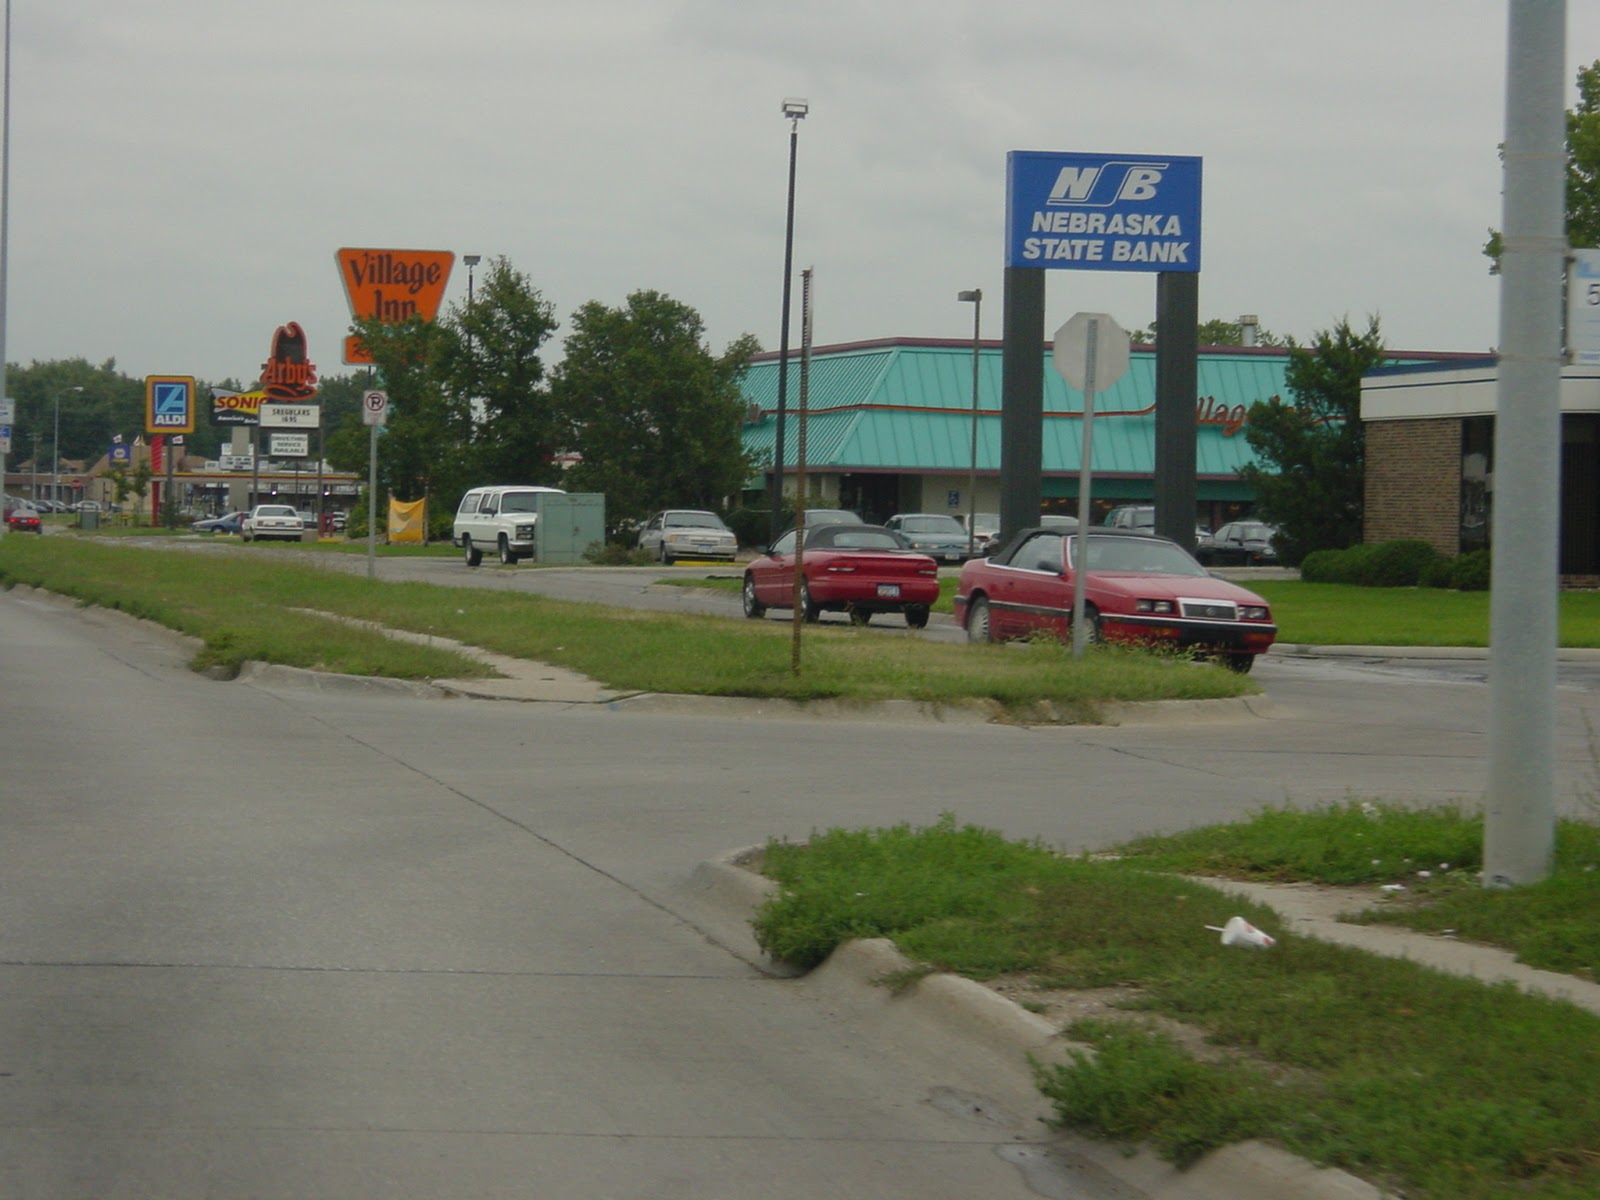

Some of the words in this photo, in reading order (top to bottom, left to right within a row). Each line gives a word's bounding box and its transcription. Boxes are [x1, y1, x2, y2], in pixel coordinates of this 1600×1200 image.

[1031, 210, 1182, 236] NEBRASKA
[1023, 237, 1105, 261] STATE
[1112, 240, 1190, 263] BANK
[350, 251, 441, 294] Village
[374, 290, 416, 322] Inn
[259, 355, 317, 387] Arby's
[155, 414, 186, 425] ALDI
